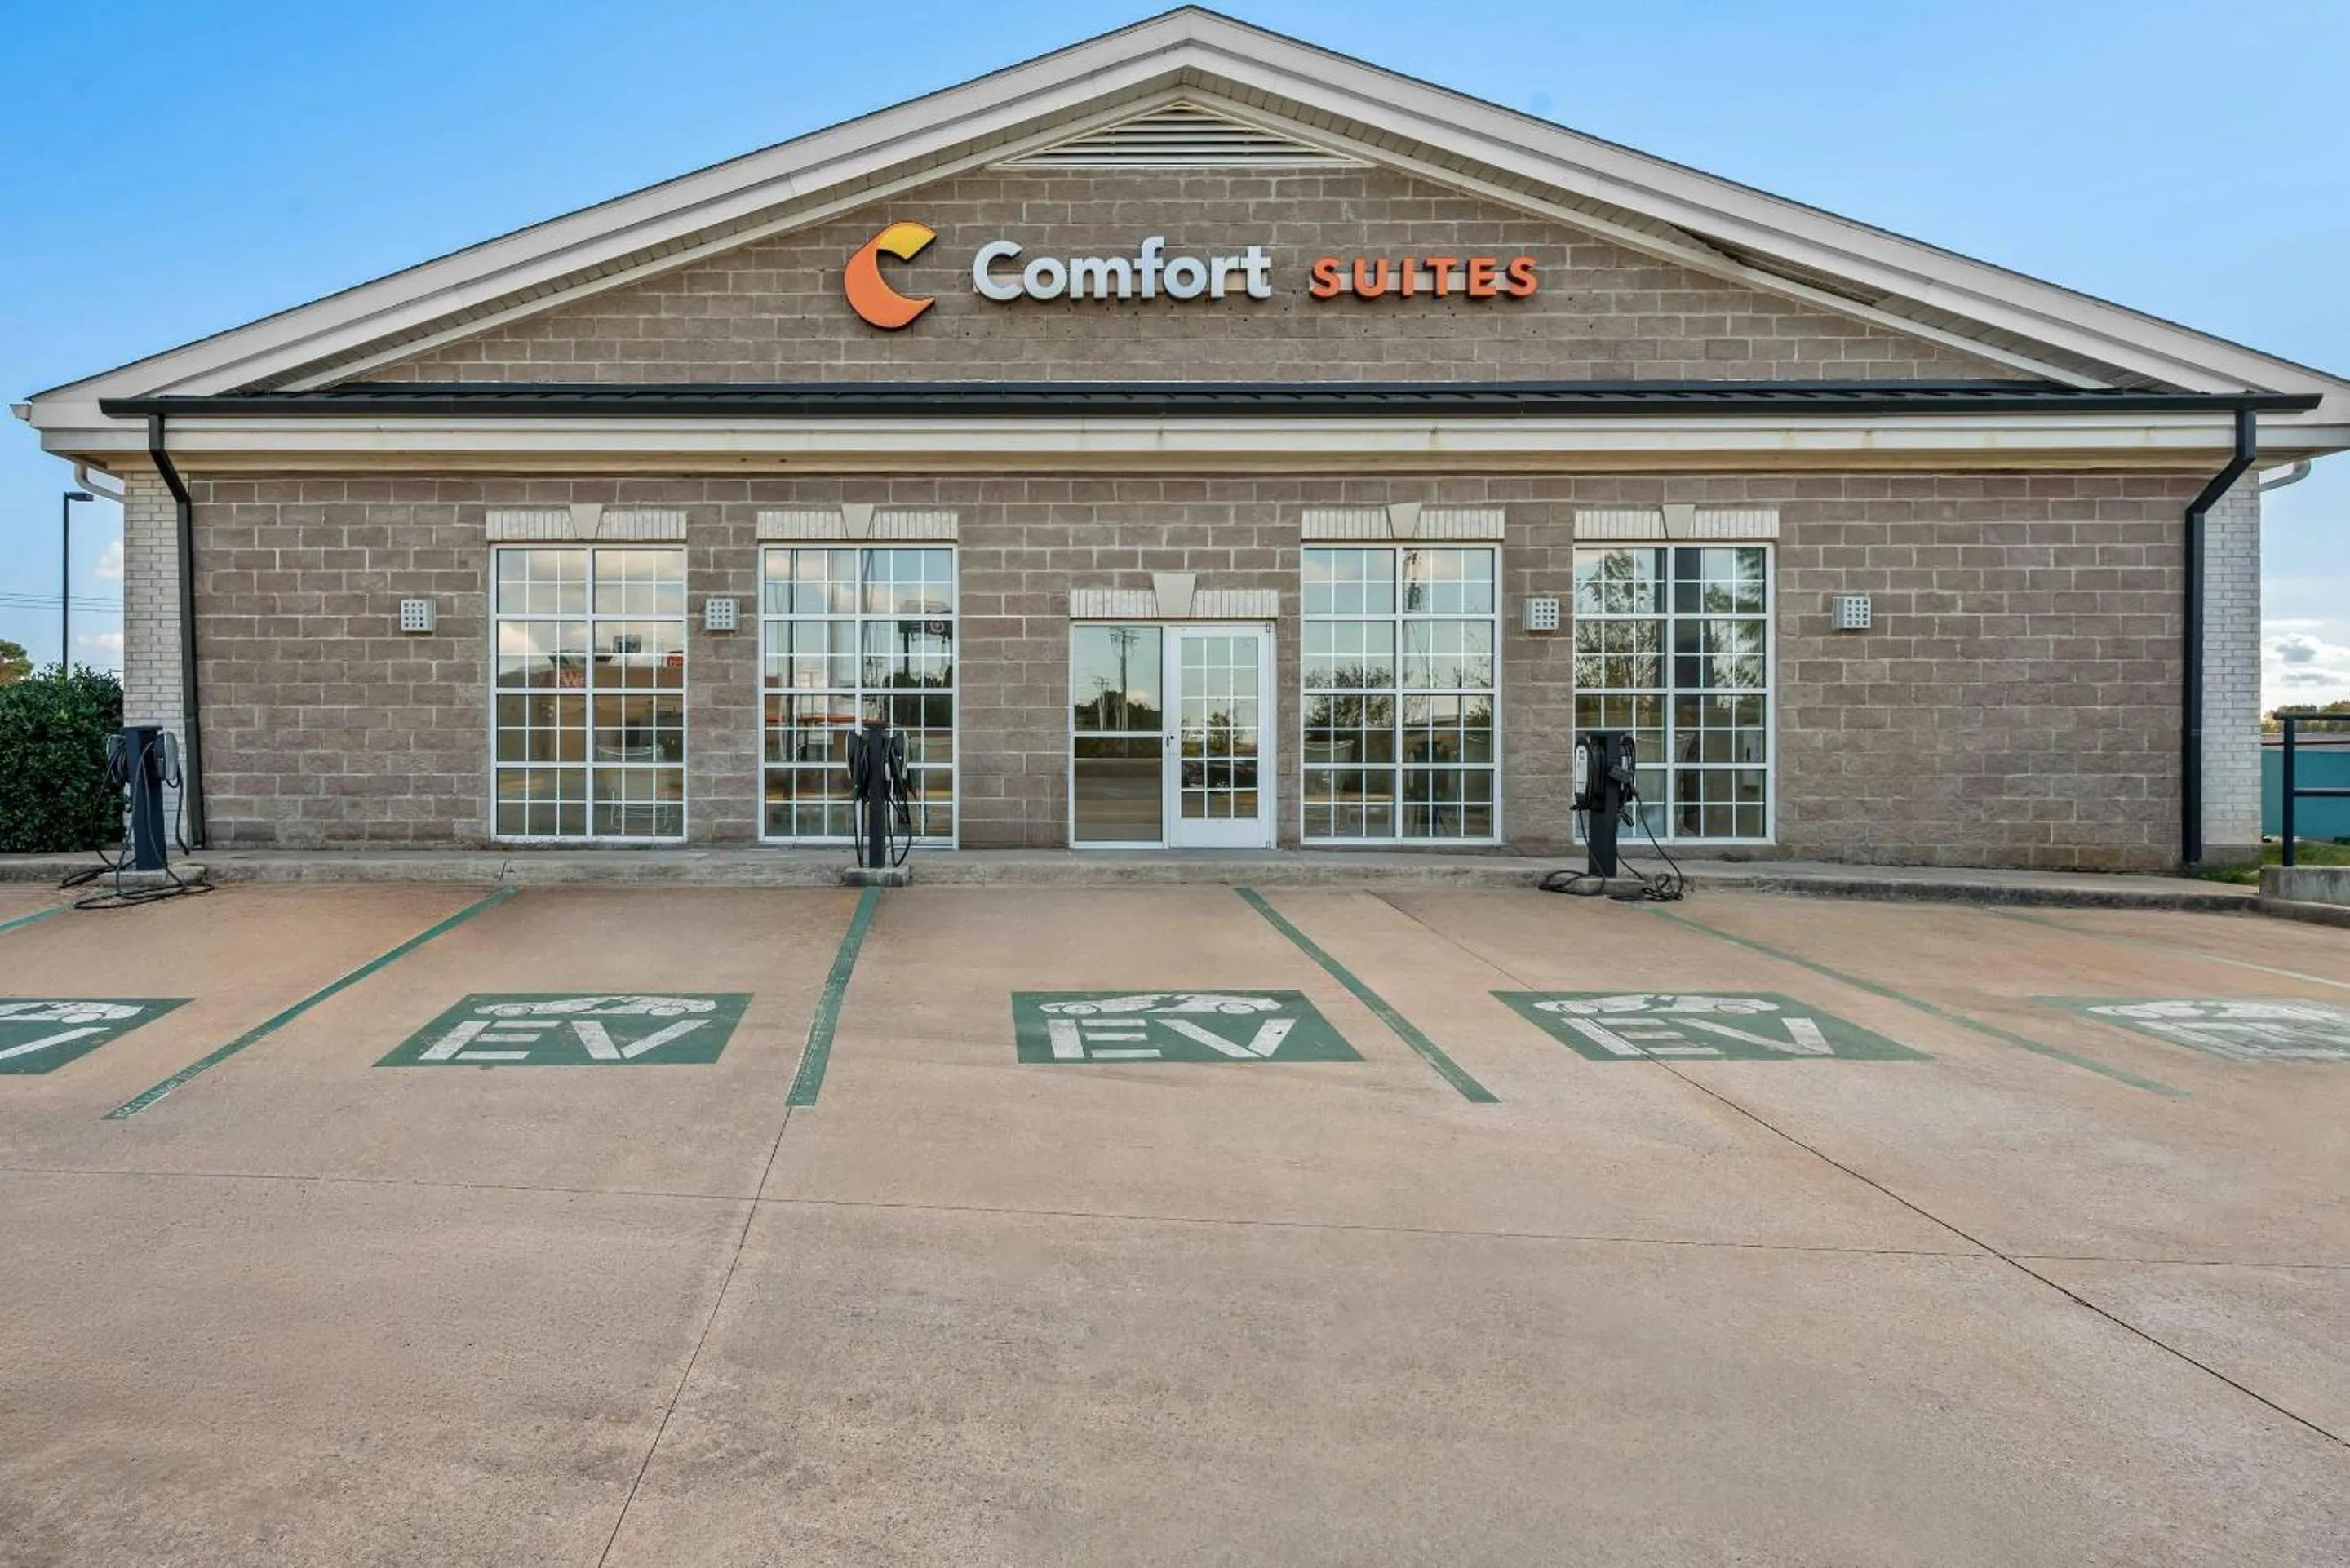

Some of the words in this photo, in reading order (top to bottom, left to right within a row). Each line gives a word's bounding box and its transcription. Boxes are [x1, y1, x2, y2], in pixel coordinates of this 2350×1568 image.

[973, 235, 1272, 301] Comfort
[1309, 256, 1539, 299] SUITES
[418, 1019, 712, 1061] EV
[1047, 1018, 1296, 1059] EV
[1561, 1017, 1835, 1055] EV
